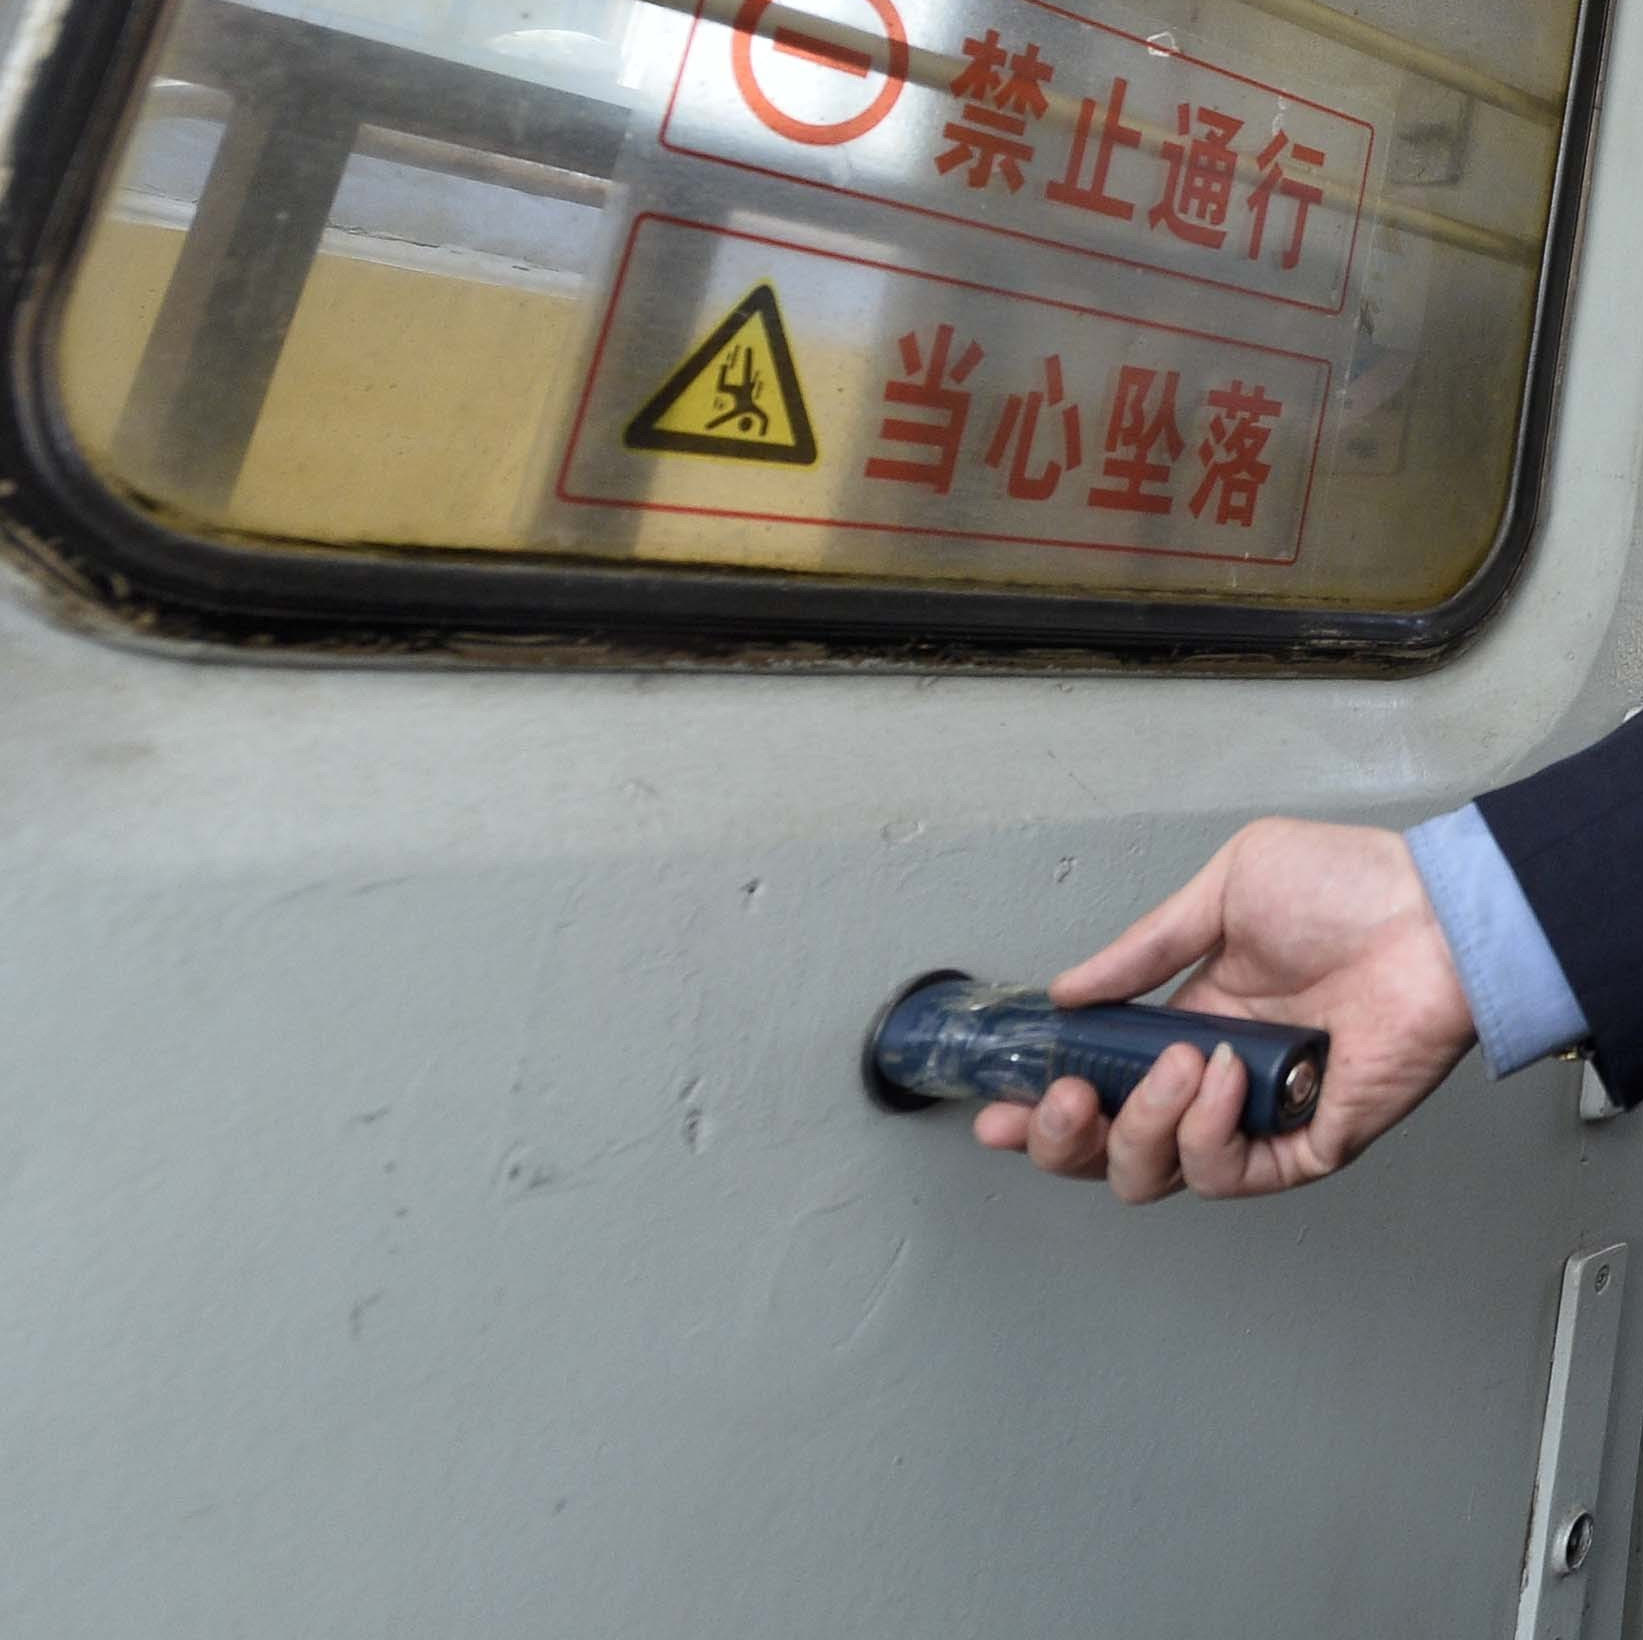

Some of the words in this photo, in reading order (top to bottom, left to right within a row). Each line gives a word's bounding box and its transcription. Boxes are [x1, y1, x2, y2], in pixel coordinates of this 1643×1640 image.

[935, 29, 1326, 271] 禁止通行
[866, 324, 1283, 527] 当心坠落
